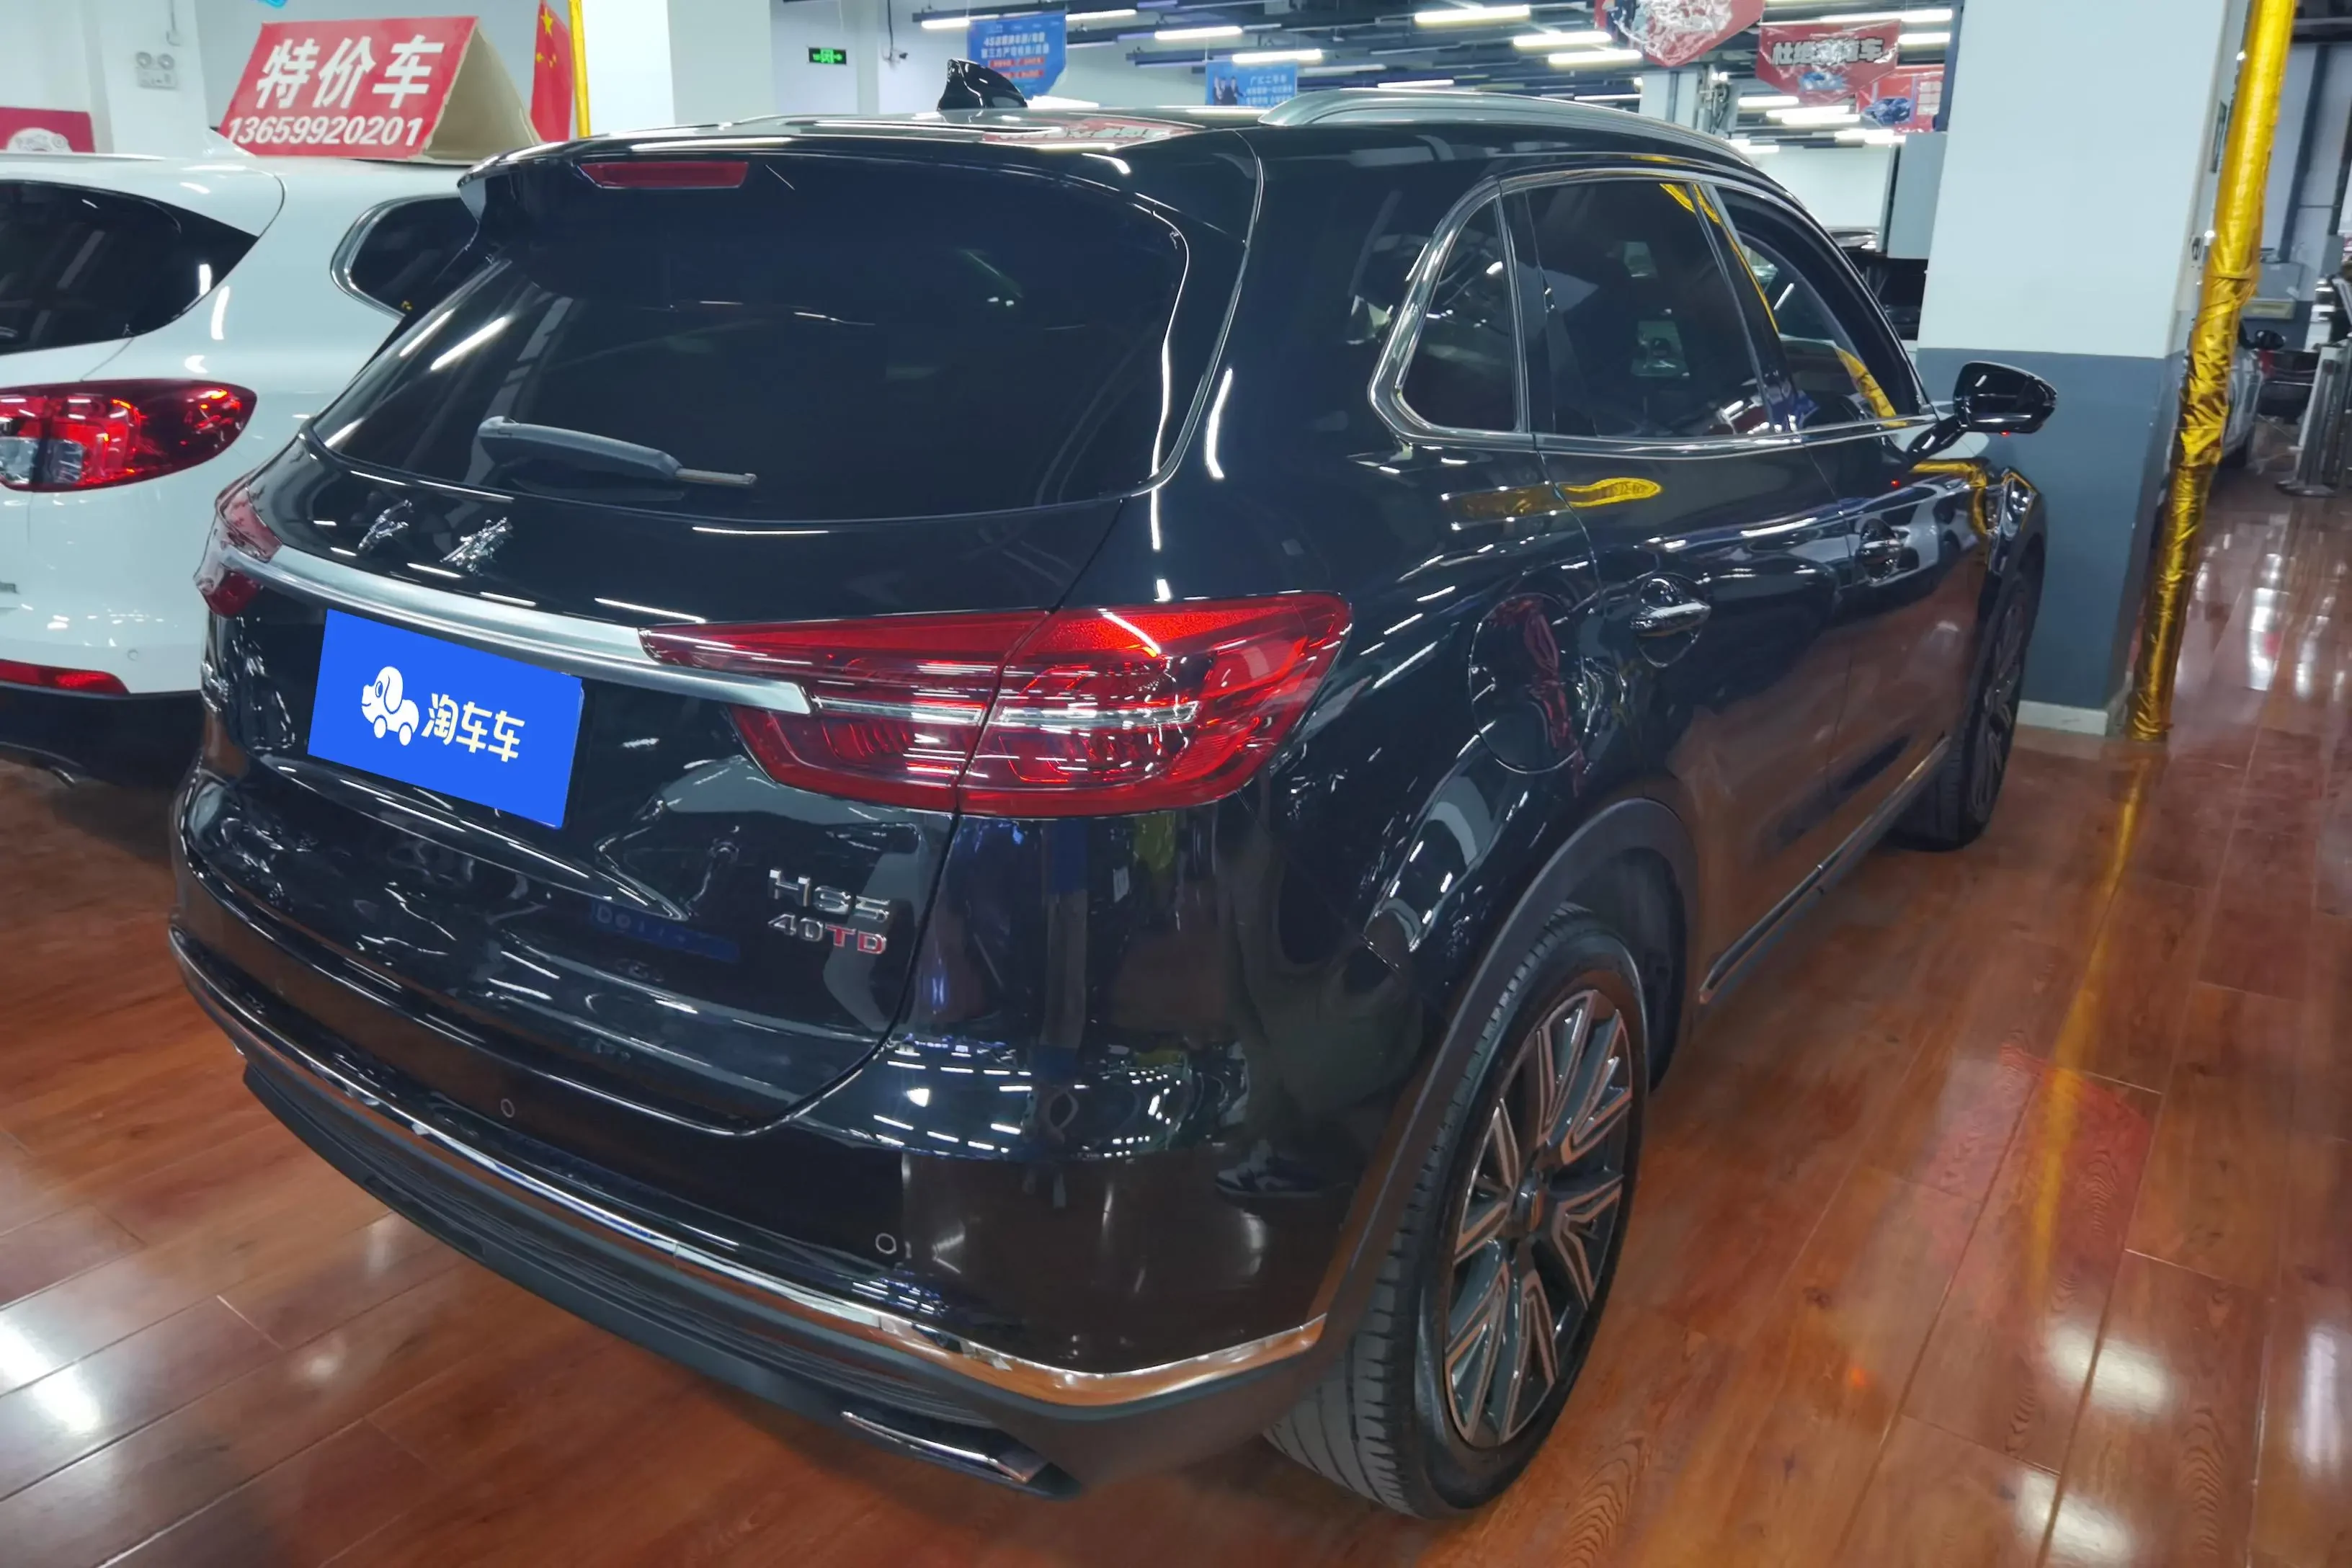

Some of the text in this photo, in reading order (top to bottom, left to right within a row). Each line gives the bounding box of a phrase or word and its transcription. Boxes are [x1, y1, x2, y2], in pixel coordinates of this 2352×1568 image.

[255, 35, 445, 110] 特价车
[226, 115, 424, 148] 13659920201
[768, 867, 891, 922] HS5
[767, 913, 887, 955] 40TD
